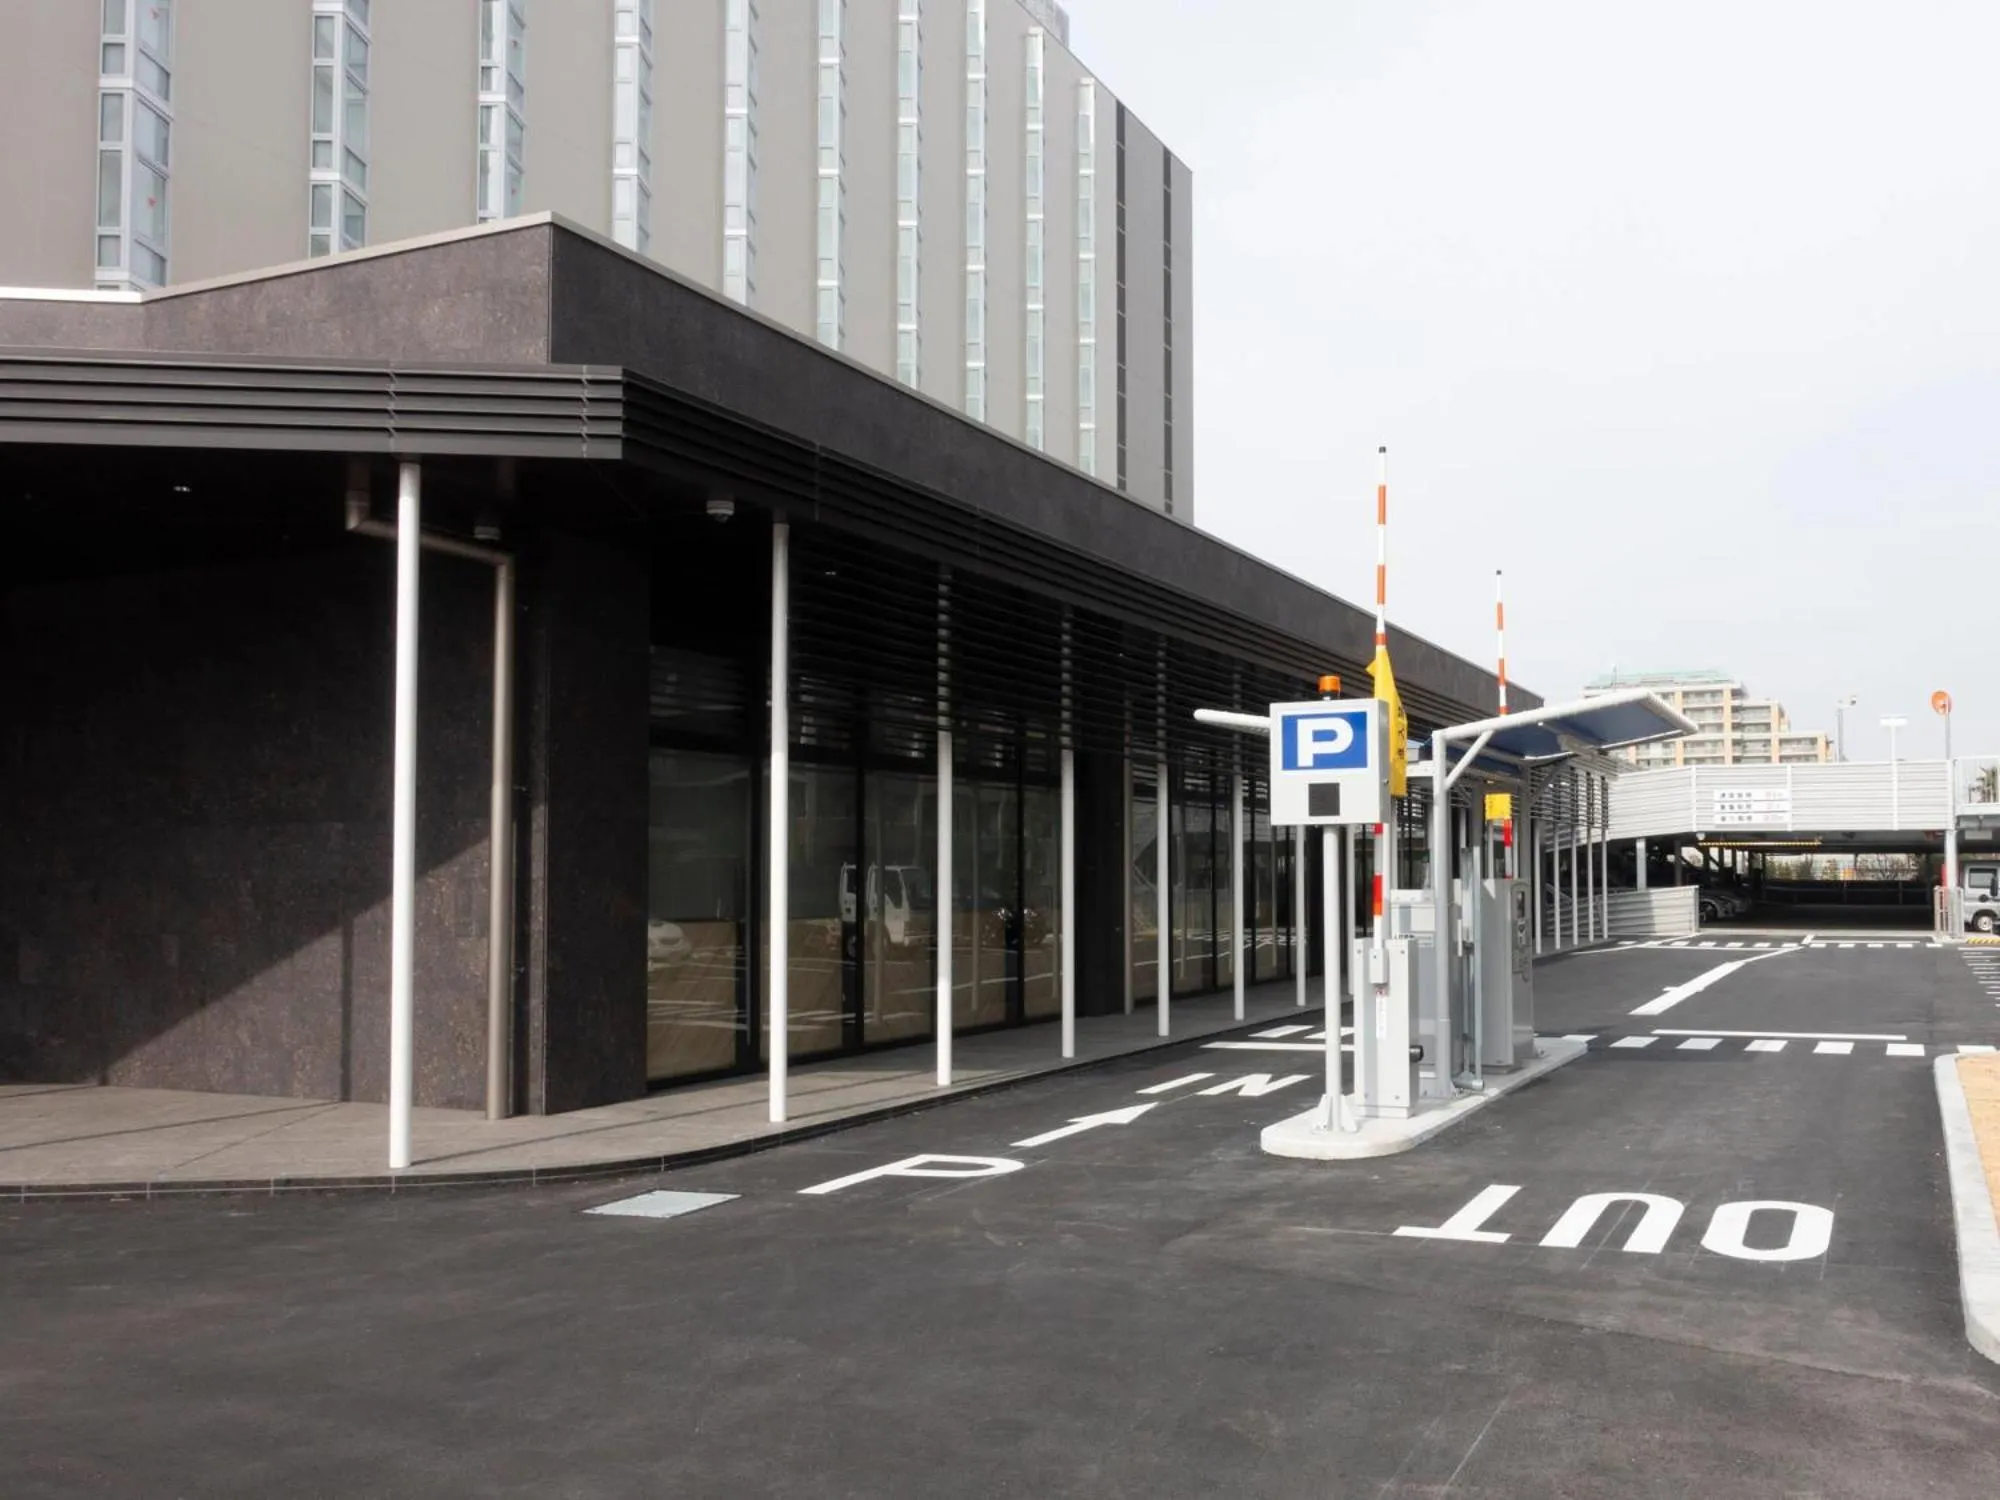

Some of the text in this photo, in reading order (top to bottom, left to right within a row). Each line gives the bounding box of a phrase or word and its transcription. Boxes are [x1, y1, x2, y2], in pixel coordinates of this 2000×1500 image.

[1297, 717, 1354, 768] P
[1135, 1073, 1312, 1096] IN
[797, 1154, 1026, 1195] P
[1391, 1184, 1835, 1263] OUT
